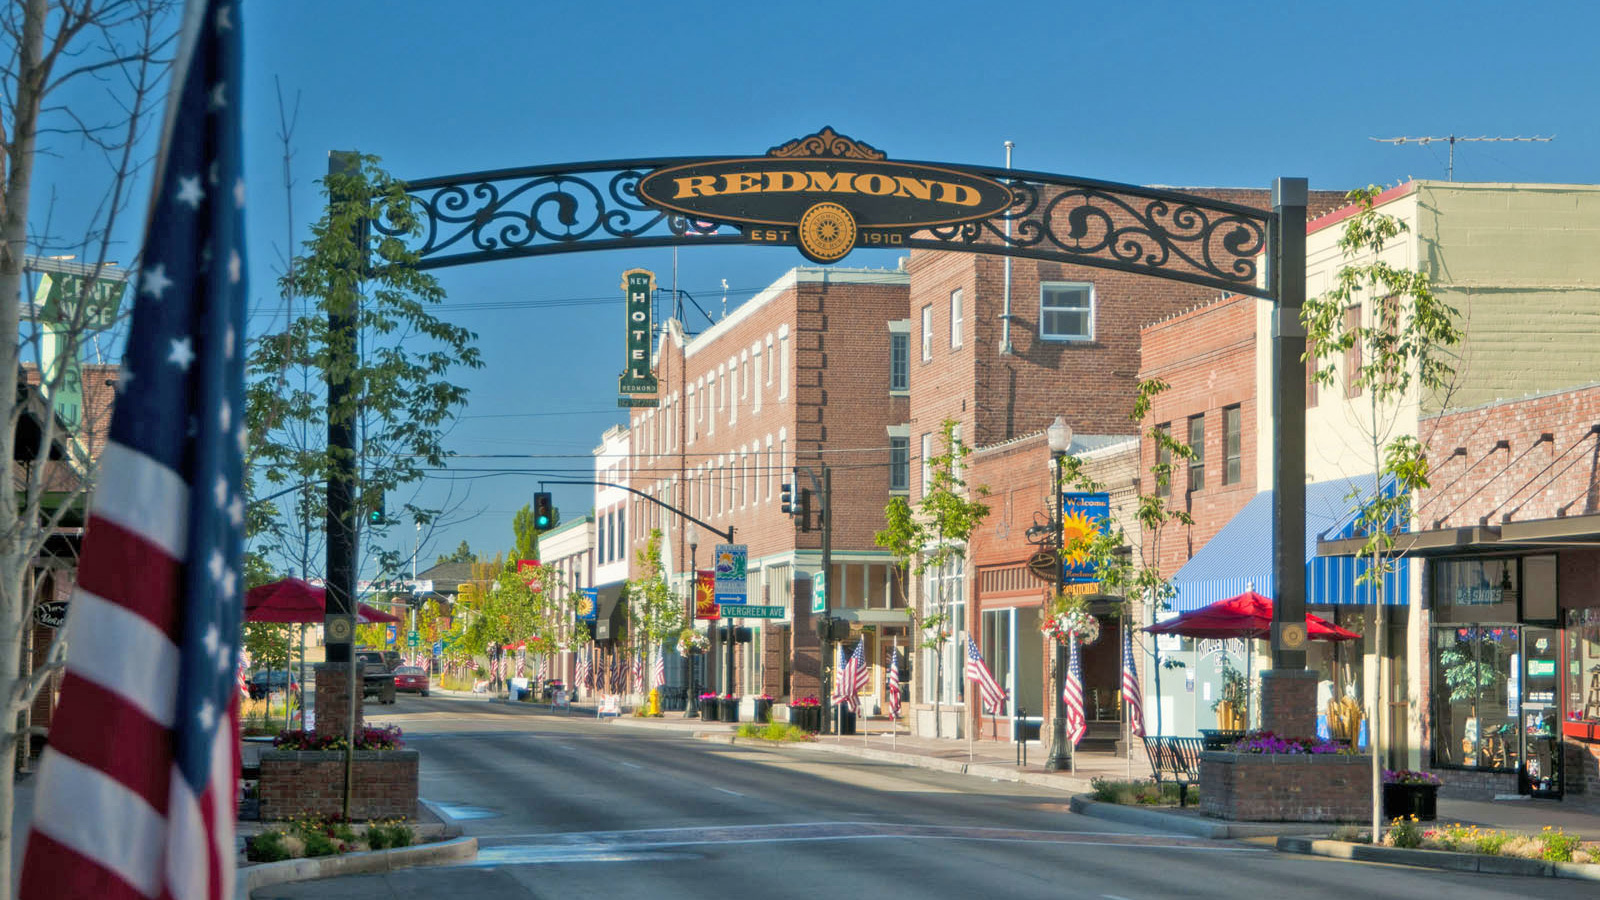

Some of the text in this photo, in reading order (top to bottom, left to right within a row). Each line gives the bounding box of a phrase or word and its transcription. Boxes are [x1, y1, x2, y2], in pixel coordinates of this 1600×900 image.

[673, 170, 982, 207] REDMOND
[751, 230, 902, 244] EST 1910
[630, 277, 649, 285] NEW
[632, 292, 646, 379] HOTEL
[1072, 582, 1099, 595] KITCHEN
[1472, 589, 1502, 601] SHOES
[722, 606, 784, 617] EVERGREEN AVE
